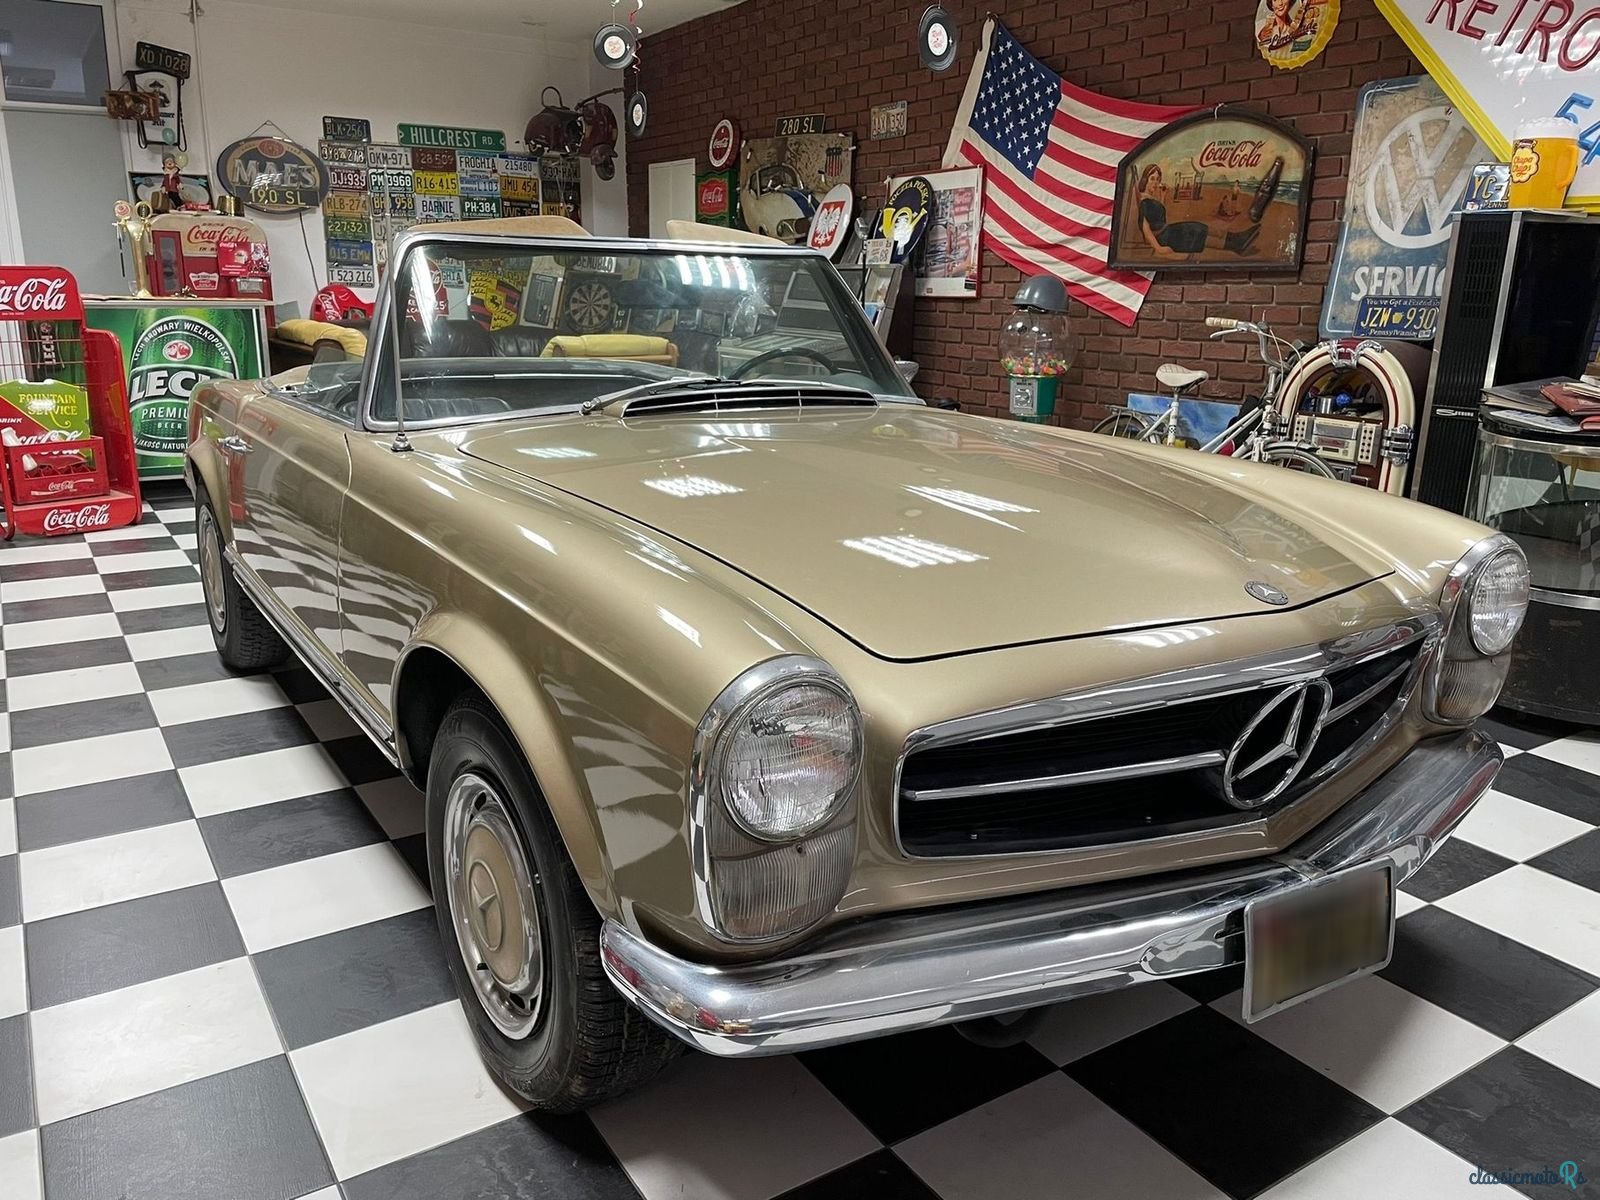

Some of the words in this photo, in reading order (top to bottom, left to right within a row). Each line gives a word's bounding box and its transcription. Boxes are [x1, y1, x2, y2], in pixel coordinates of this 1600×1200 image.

[139, 47, 155, 64] XD
[781, 118, 800, 136] 280
[802, 117, 816, 134] SL
[410, 126, 478, 148] HILLCREST
[1199, 140, 1265, 168] Coca-Cola
[231, 160, 316, 188] MAES
[505, 160, 532, 172] 215480
[502, 179, 518, 191] JMU
[522, 181, 537, 193] 454
[250, 189, 277, 204] 190
[285, 191, 306, 206] SL
[422, 200, 455, 214] BARNIE
[187, 225, 249, 244] Coca-Cola
[337, 270, 354, 282] 523
[356, 270, 372, 283] 216
[1360, 307, 1393, 328] JZW
[1404, 307, 1437, 330] 930
[144, 322, 180, 343] BROWARY
[183, 322, 232, 364] WIELKOPOLSKI
[130, 370, 211, 402] LEC
[18, 393, 77, 405] FOUNTAIN
[27, 404, 78, 416] SERVICE
[157, 421, 182, 430] BEER
[48, 480, 75, 491] Coca-Cola
[43, 504, 111, 531] Coca-Cola
